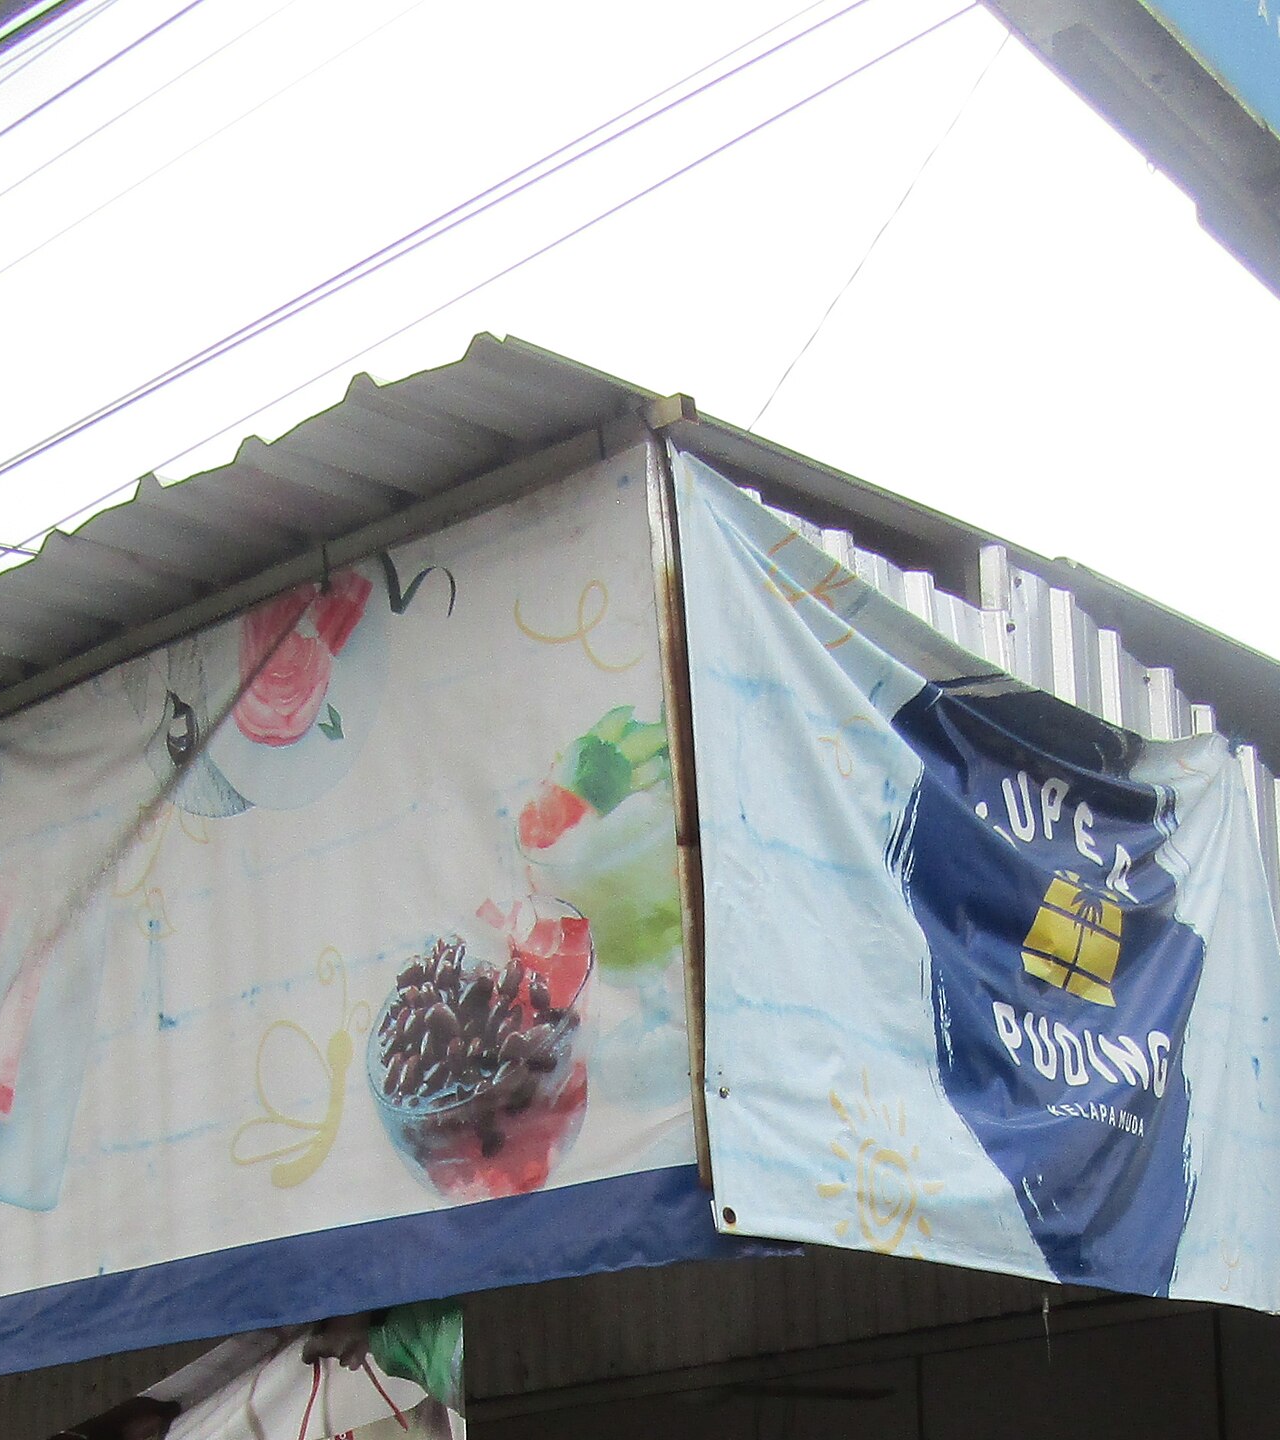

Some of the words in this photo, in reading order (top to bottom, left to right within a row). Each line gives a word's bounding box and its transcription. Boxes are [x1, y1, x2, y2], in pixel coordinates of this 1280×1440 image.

[992, 1000, 1173, 1098] PUDING
[1046, 1103, 1117, 1127] KELAPA
[1118, 1108, 1145, 1138] MUDA
